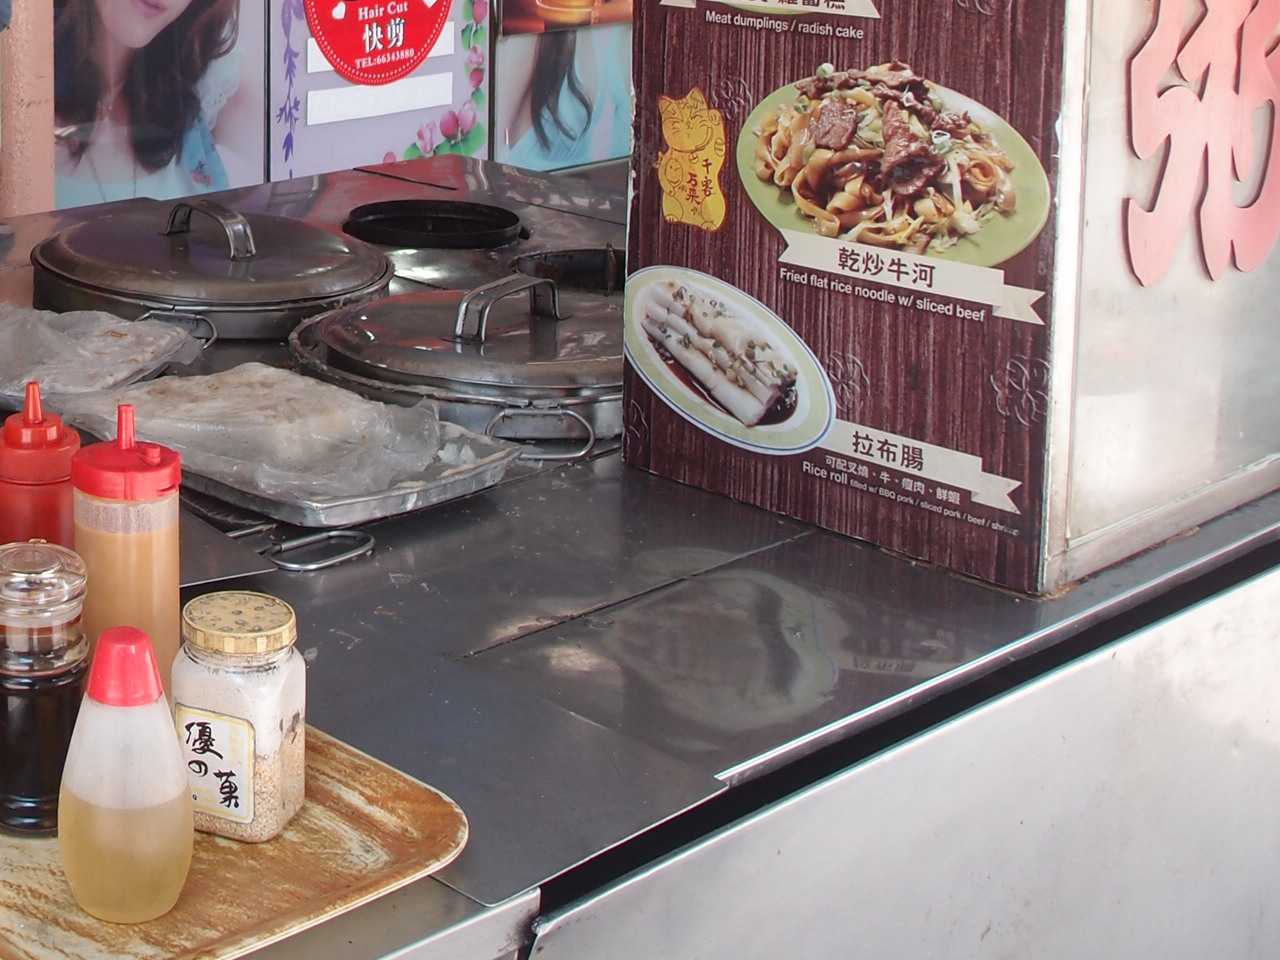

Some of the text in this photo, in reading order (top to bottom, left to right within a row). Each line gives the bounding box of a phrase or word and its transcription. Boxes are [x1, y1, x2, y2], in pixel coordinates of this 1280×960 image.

[358, 1, 408, 21] Hair Cut
[706, 10, 865, 39] Meat dumplings / radish cake
[363, 17, 405, 53] 快剪
[837, 246, 936, 288] 乾炒牛河
[780, 268, 986, 322] Fried flat rice noodle w/ sliced beef
[852, 430, 924, 472] 拉布腸
[802, 461, 827, 479] Rice
[829, 470, 848, 485] roll
[850, 479, 867, 492] filled
[879, 487, 896, 500] BBQ
[897, 493, 914, 506] pork
[920, 501, 942, 514] sliced
[943, 507, 961, 520] pork
[967, 514, 986, 527] beef
